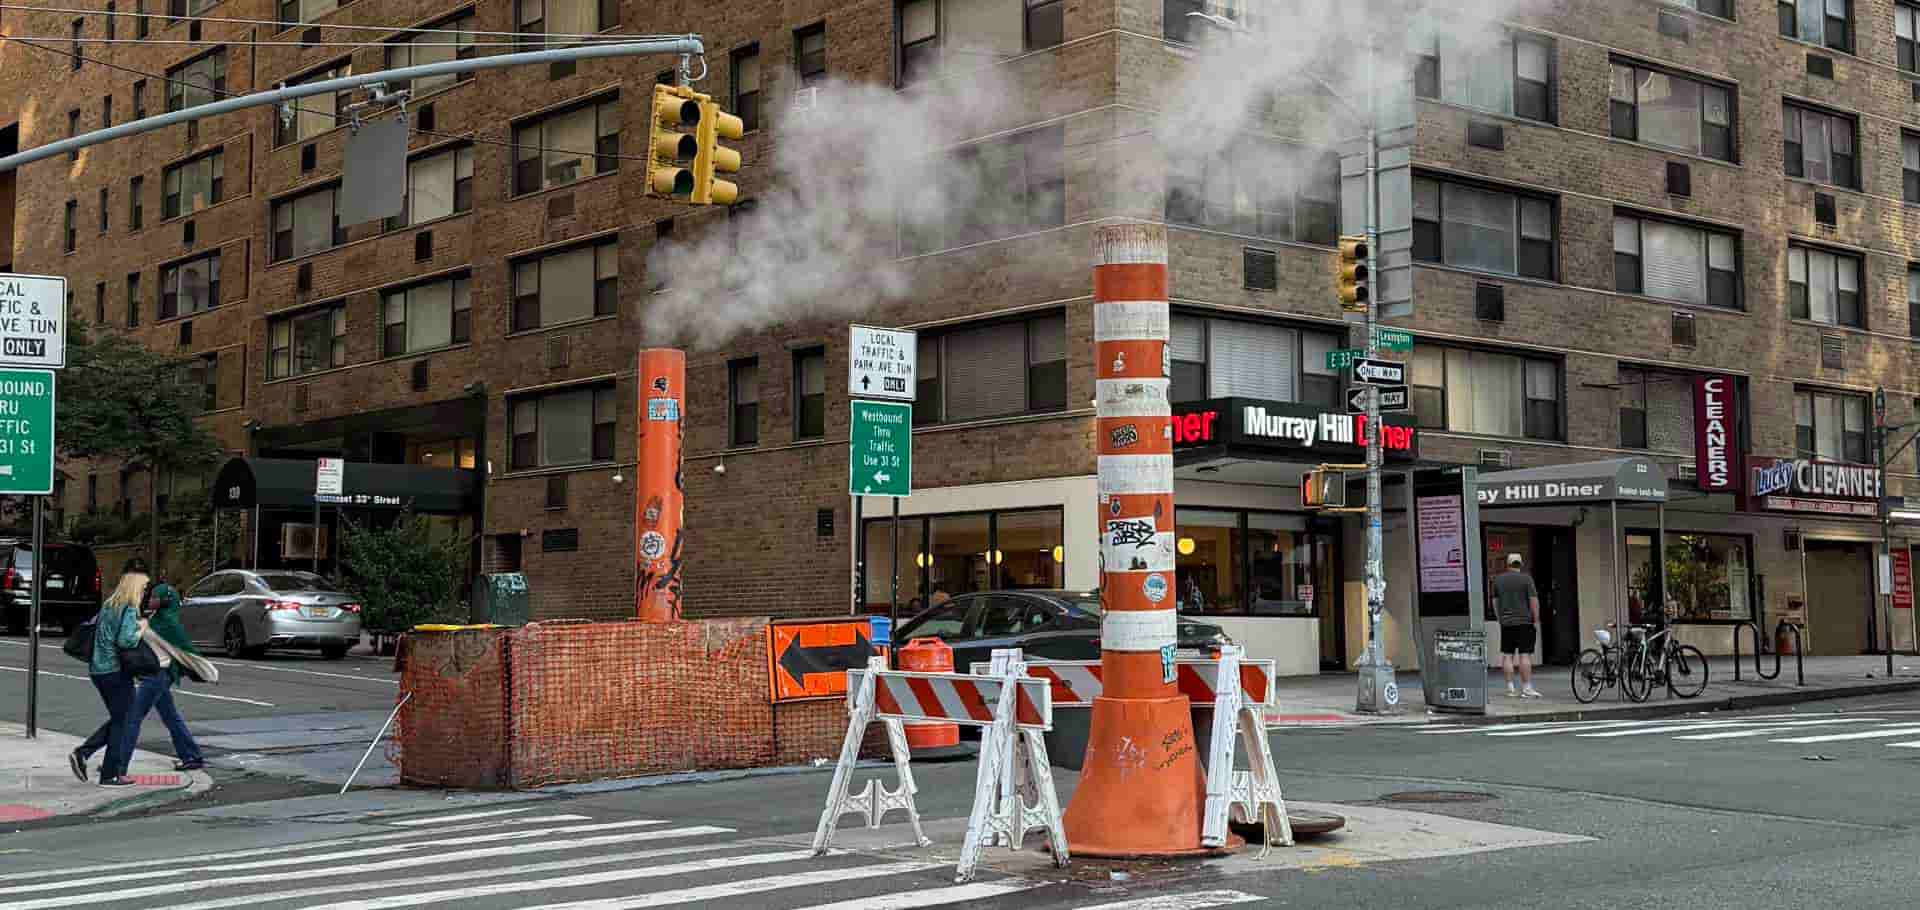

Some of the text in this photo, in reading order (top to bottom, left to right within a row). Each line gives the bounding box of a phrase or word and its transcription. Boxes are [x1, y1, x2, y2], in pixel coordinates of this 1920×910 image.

[31, 301, 41, 315] &
[30, 319, 57, 334] TUN
[870, 333, 895, 346] LOCAL
[6, 340, 43, 355] ONLY
[861, 345, 905, 361] TRAFFIC &
[854, 359, 912, 375] PARK AVE TUN
[1360, 366, 1399, 378] ONE WAY
[884, 378, 905, 391] ONLY
[1383, 392, 1400, 404] WAY
[862, 409, 903, 425] Westbound
[874, 425, 891, 438] Thru
[1171, 411, 1217, 443] ner
[1244, 406, 1414, 450] Murray Hill Dner
[1703, 378, 1729, 487] CLEANERS
[21, 439, 35, 455] St
[869, 439, 895, 453] Traffic
[863, 454, 900, 468] Use 31 St
[1505, 485, 1540, 500] Hill
[1545, 482, 1603, 498] Diner
[373, 496, 400, 505] Street
